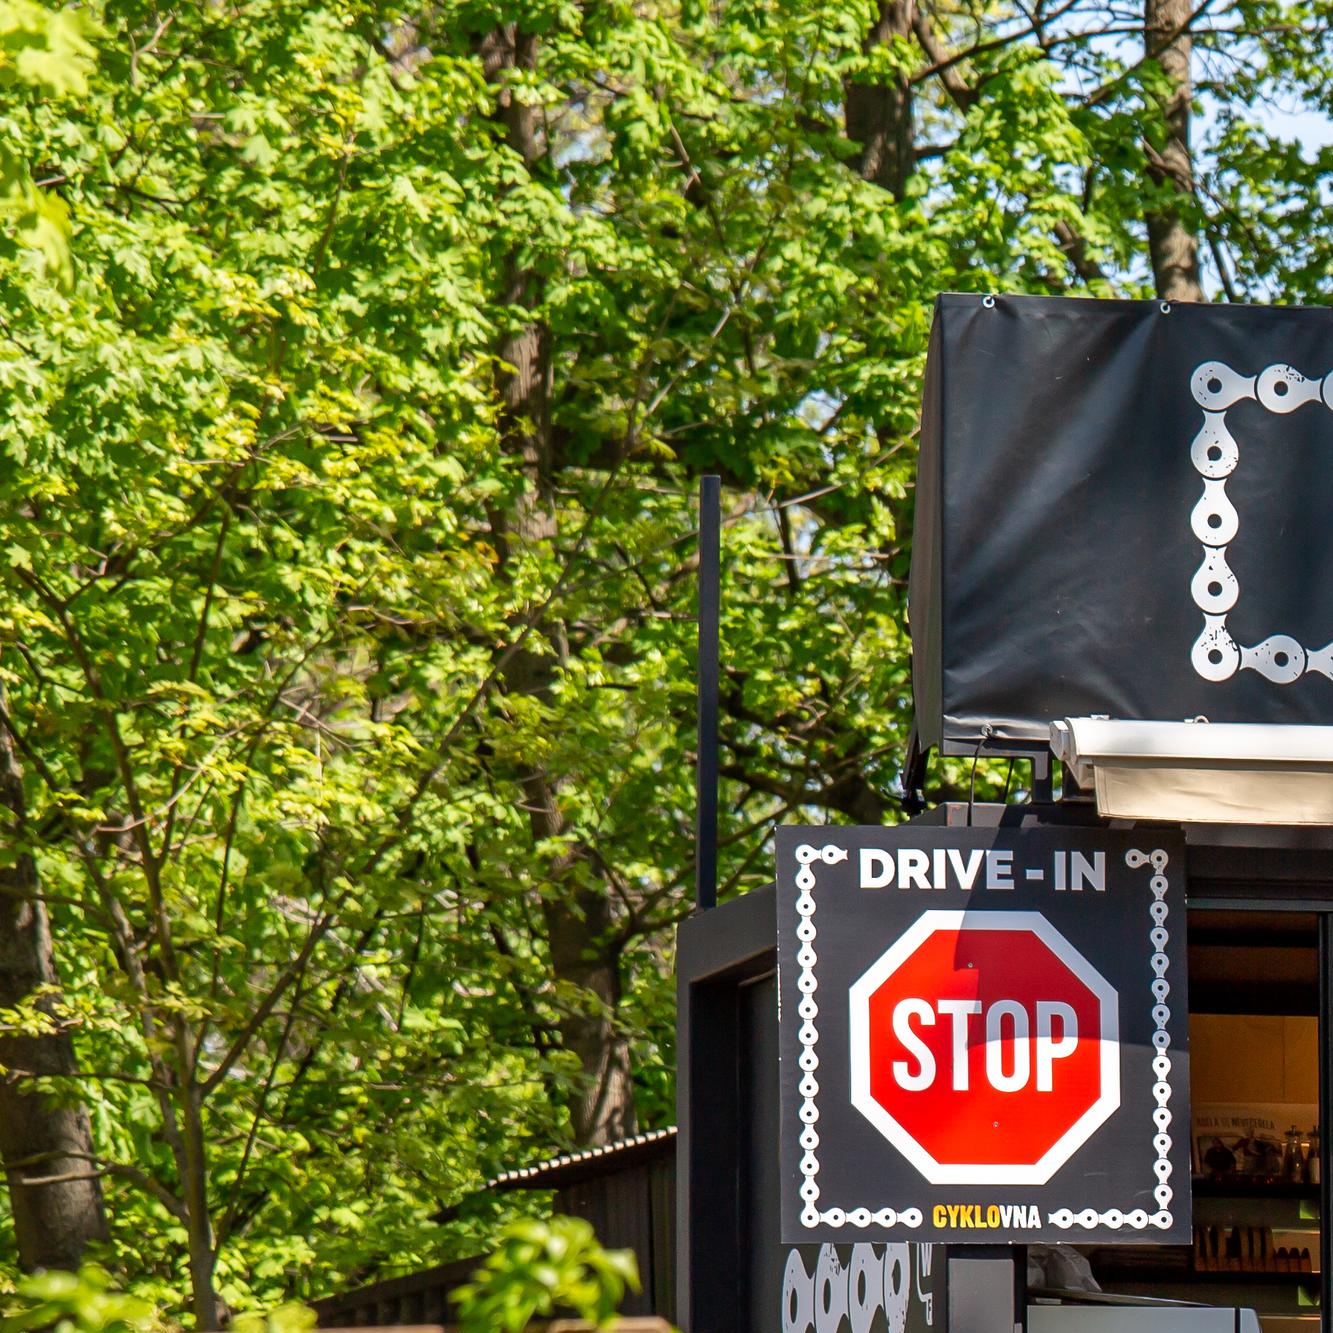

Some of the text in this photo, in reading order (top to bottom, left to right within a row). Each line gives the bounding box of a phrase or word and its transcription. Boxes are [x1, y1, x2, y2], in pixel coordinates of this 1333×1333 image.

[859, 848, 1015, 890] DRIVE
[1054, 850, 1106, 891] IN
[891, 997, 1079, 1093] STOP
[932, 1204, 1042, 1230] CYKLOVNA
